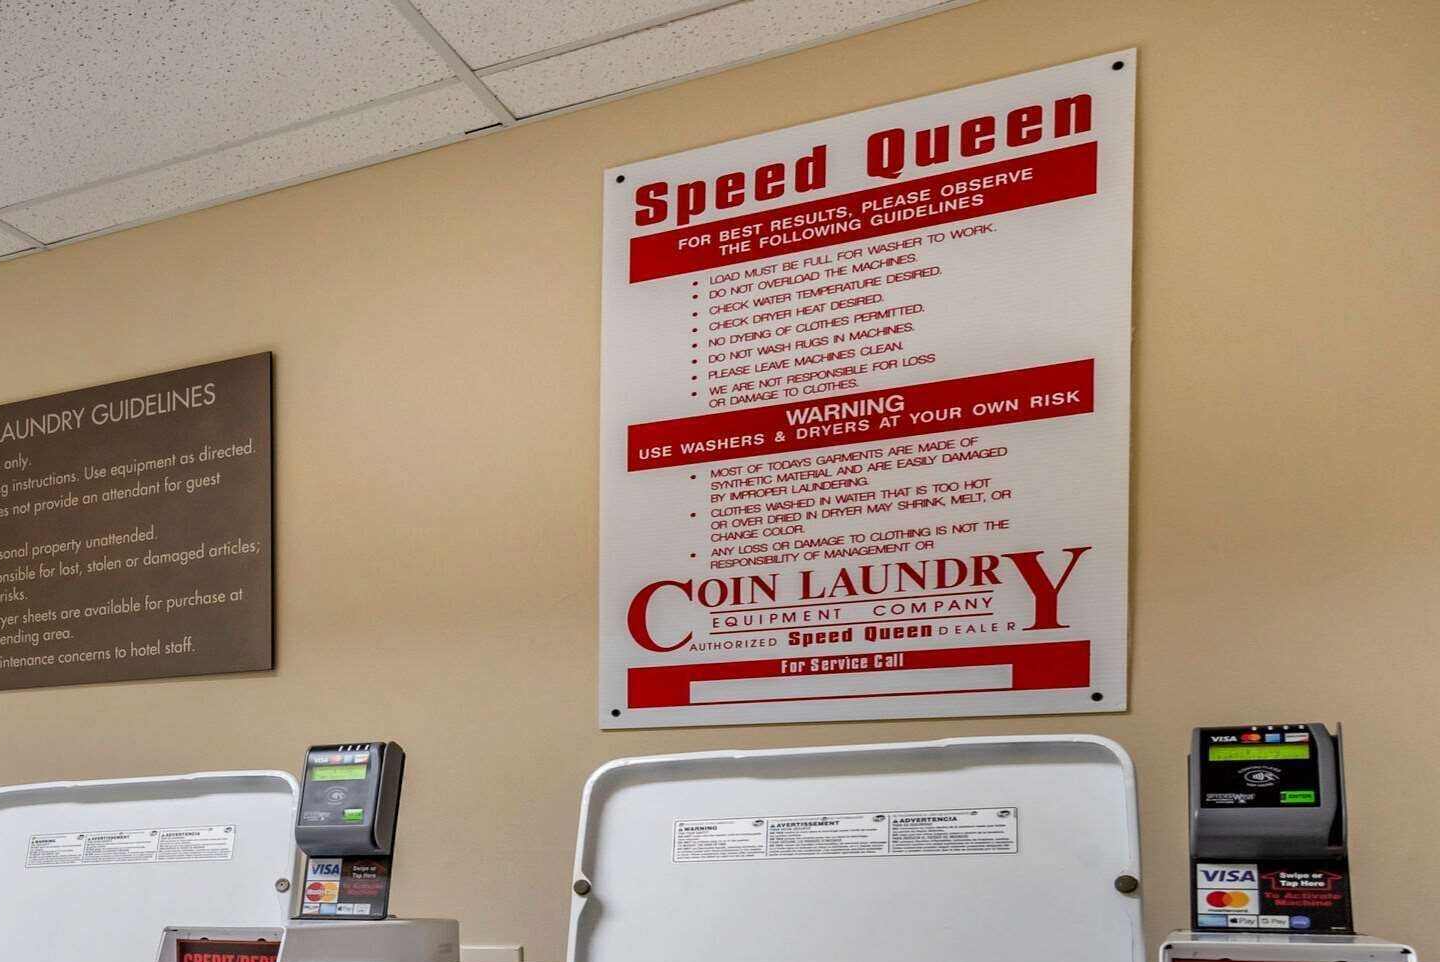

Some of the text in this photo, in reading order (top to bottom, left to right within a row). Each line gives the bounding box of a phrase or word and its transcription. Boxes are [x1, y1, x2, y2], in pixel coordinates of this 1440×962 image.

[635, 93, 1092, 227] Speed Queen
[678, 167, 1033, 250] FOR BEST RESULTS, PLEASE OBSERVE
[718, 193, 984, 256] THE FOLLOWING GUIDELINES
[709, 223, 997, 285] LOAD MUST BE FULL FOR WASHER TO WORK.
[708, 266, 940, 315] CHECK WATER TEMPERATURE DESIRED.
[709, 253, 916, 300] DO NOT OVERLOAD THE MACHINES.
[708, 293, 883, 331] CHECK DRYER HEAT DESIRED.
[708, 322, 914, 364] DO NOT WASH RUGS IN MACHINES.
[708, 341, 904, 380] PLEASE LEAVE MACHINES CLEAN.
[708, 378, 859, 409] OR DAMAGE TO CLOTHES.
[709, 353, 936, 396] WE ARE NOT RESPONSIBLE FOR LOSS
[91, 382, 216, 425] GUIDELINES
[785, 394, 905, 426] WARNING
[639, 390, 1081, 460] USE WASHERS & DRYERS AT YOUR OWN RISK
[3, 453, 32, 472] only.
[12, 471, 80, 492] instructions.
[84, 465, 107, 481] Use
[110, 453, 176, 478] equipment
[179, 453, 195, 465] as
[198, 437, 256, 462] directed.
[12, 501, 31, 515] not
[34, 492, 79, 516] provide
[82, 493, 98, 505] an
[101, 481, 161, 502] attendant
[164, 476, 183, 493] for
[185, 471, 221, 493] guest
[39, 563, 56, 579] for
[59, 561, 83, 577] lost,
[87, 555, 122, 573] stolen
[125, 557, 140, 568] or
[143, 543, 205, 566] damaged
[208, 538, 261, 558] articles;
[0, 586, 28, 602] risks.
[627, 546, 1092, 653] COIN LAUNDRY
[712, 596, 993, 629] EQUIPMENT COMPANY
[57, 650, 111, 664] concerns
[115, 646, 127, 659] to
[130, 639, 161, 657] hotel
[165, 636, 196, 655] staff.
[688, 621, 1016, 652] AUTHORIZED Speed Queen DEALER
[781, 653, 904, 674] For Service Call
[1210, 735, 1238, 743] VISA
[776, 820, 840, 828] AVERTISSEMENT
[899, 816, 958, 824] ADVERTENCIA
[311, 863, 340, 875] VISA
[1200, 870, 1256, 882] VISA
[1279, 872, 1310, 880] Swipe
[1279, 880, 1298, 888] Tap
